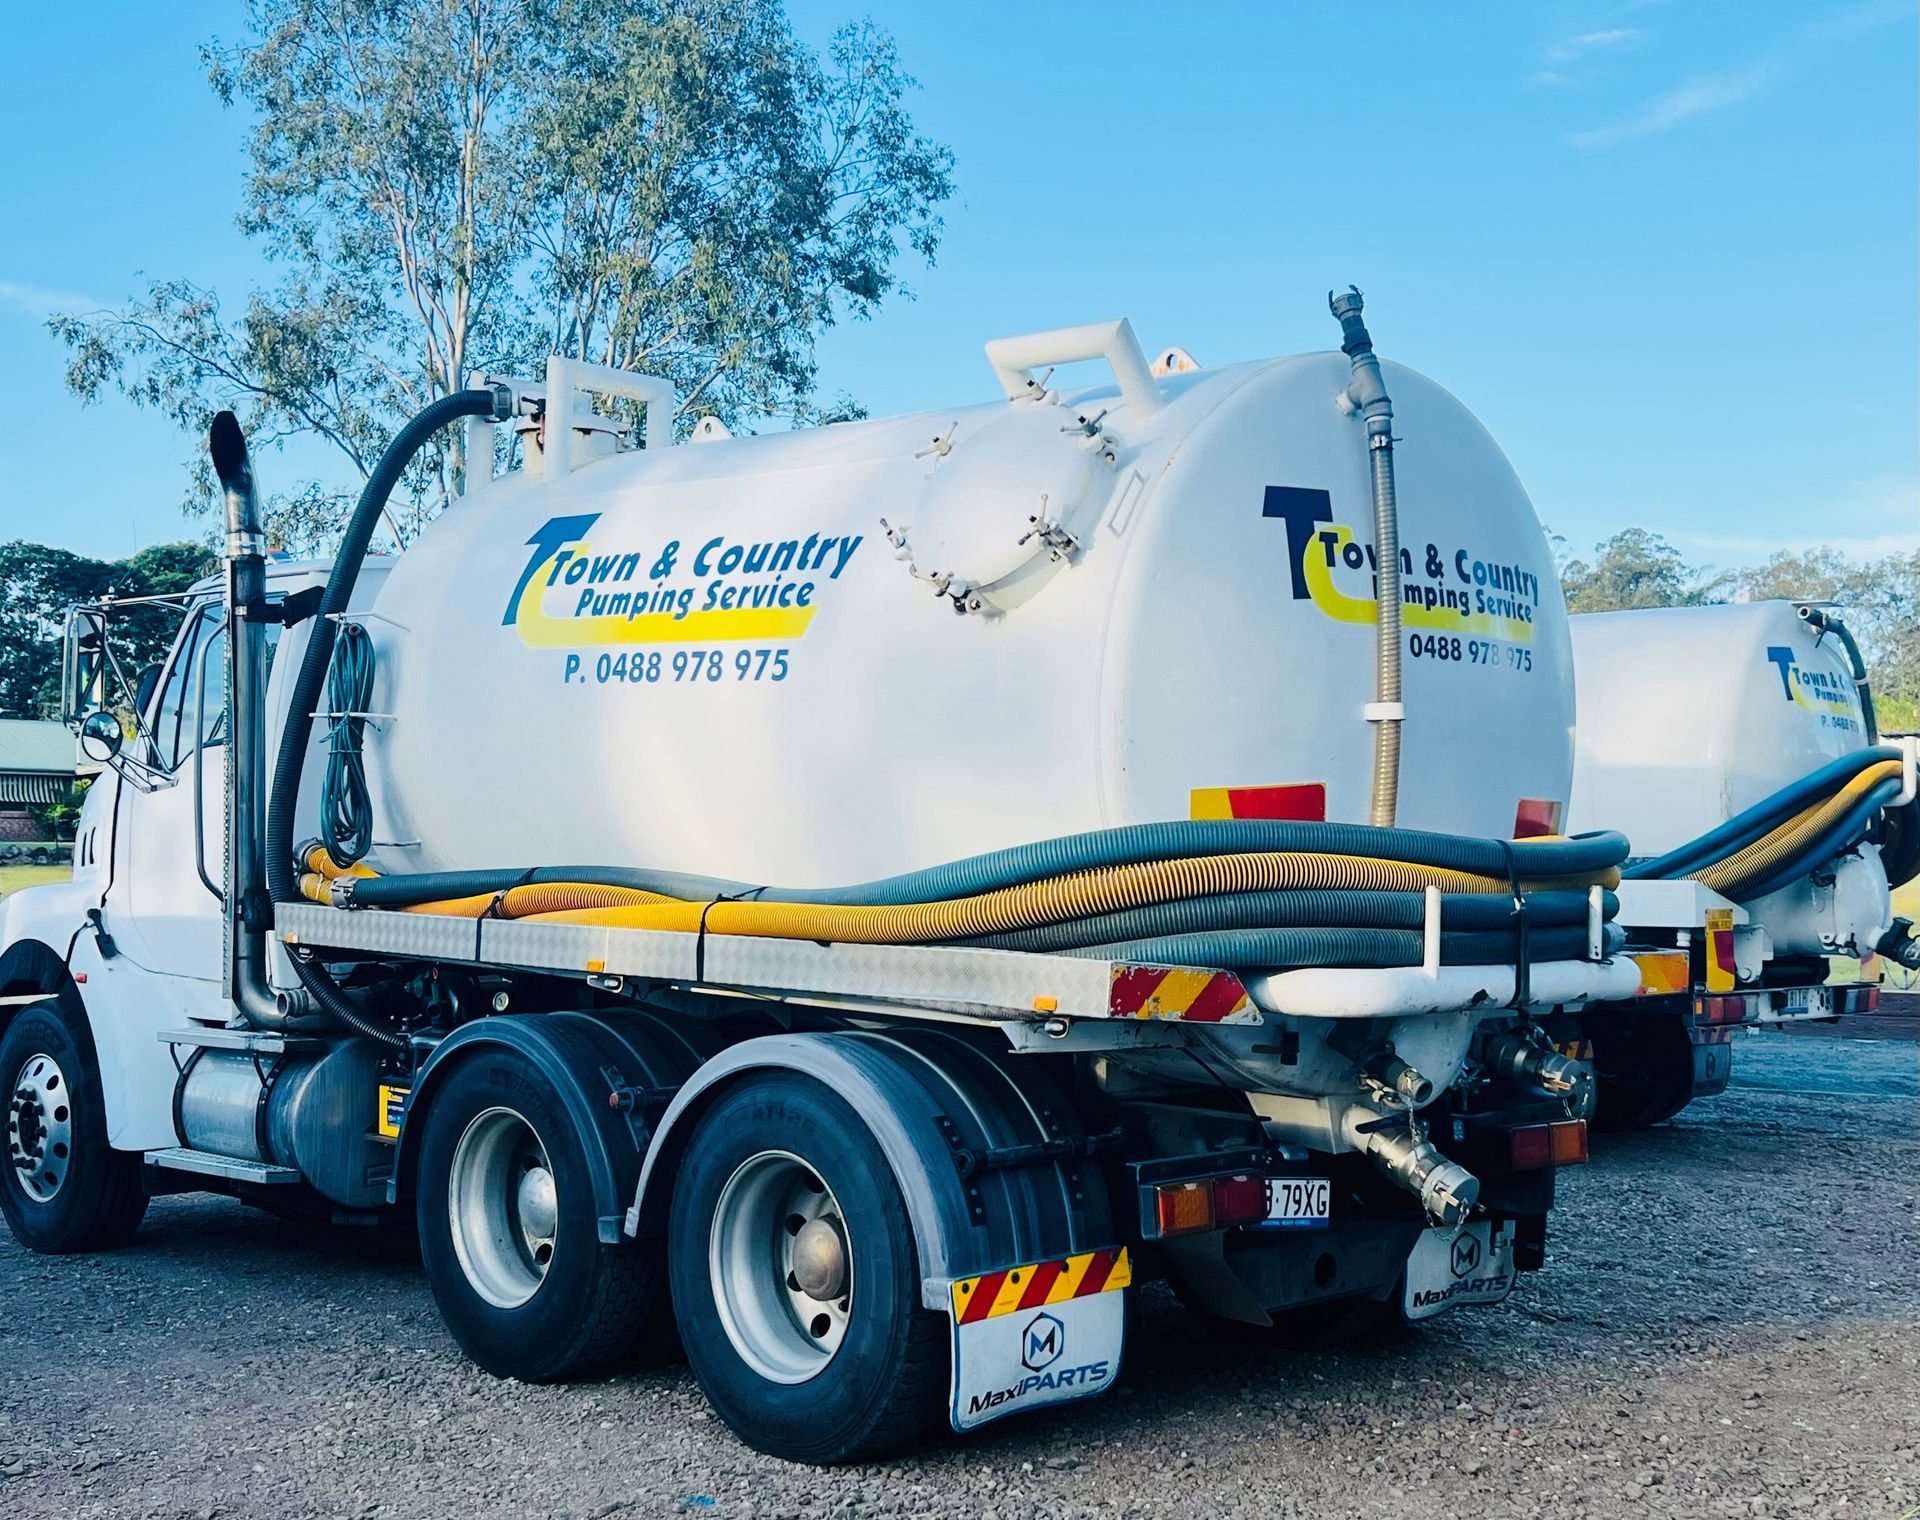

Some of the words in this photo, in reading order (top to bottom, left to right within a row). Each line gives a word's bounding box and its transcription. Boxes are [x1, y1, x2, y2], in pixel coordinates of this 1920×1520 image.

[546, 549, 641, 587] Town
[650, 540, 680, 580] &
[693, 532, 864, 579] Country
[1425, 543, 1444, 579] &
[1455, 549, 1539, 607] Country
[574, 581, 696, 621] Pumping
[701, 575, 815, 611] Service
[1372, 574, 1470, 617] mping
[1476, 588, 1533, 624] Service
[564, 654, 586, 684] P.
[597, 652, 661, 683] 0488
[672, 650, 724, 682] 978
[735, 649, 790, 682] 975
[1409, 633, 1462, 662] 0488
[1468, 640, 1499, 667] 978
[1507, 646, 1532, 673] 975
[1792, 667, 1828, 688] Town
[968, 1360, 1109, 1415] MaxiPARTS
